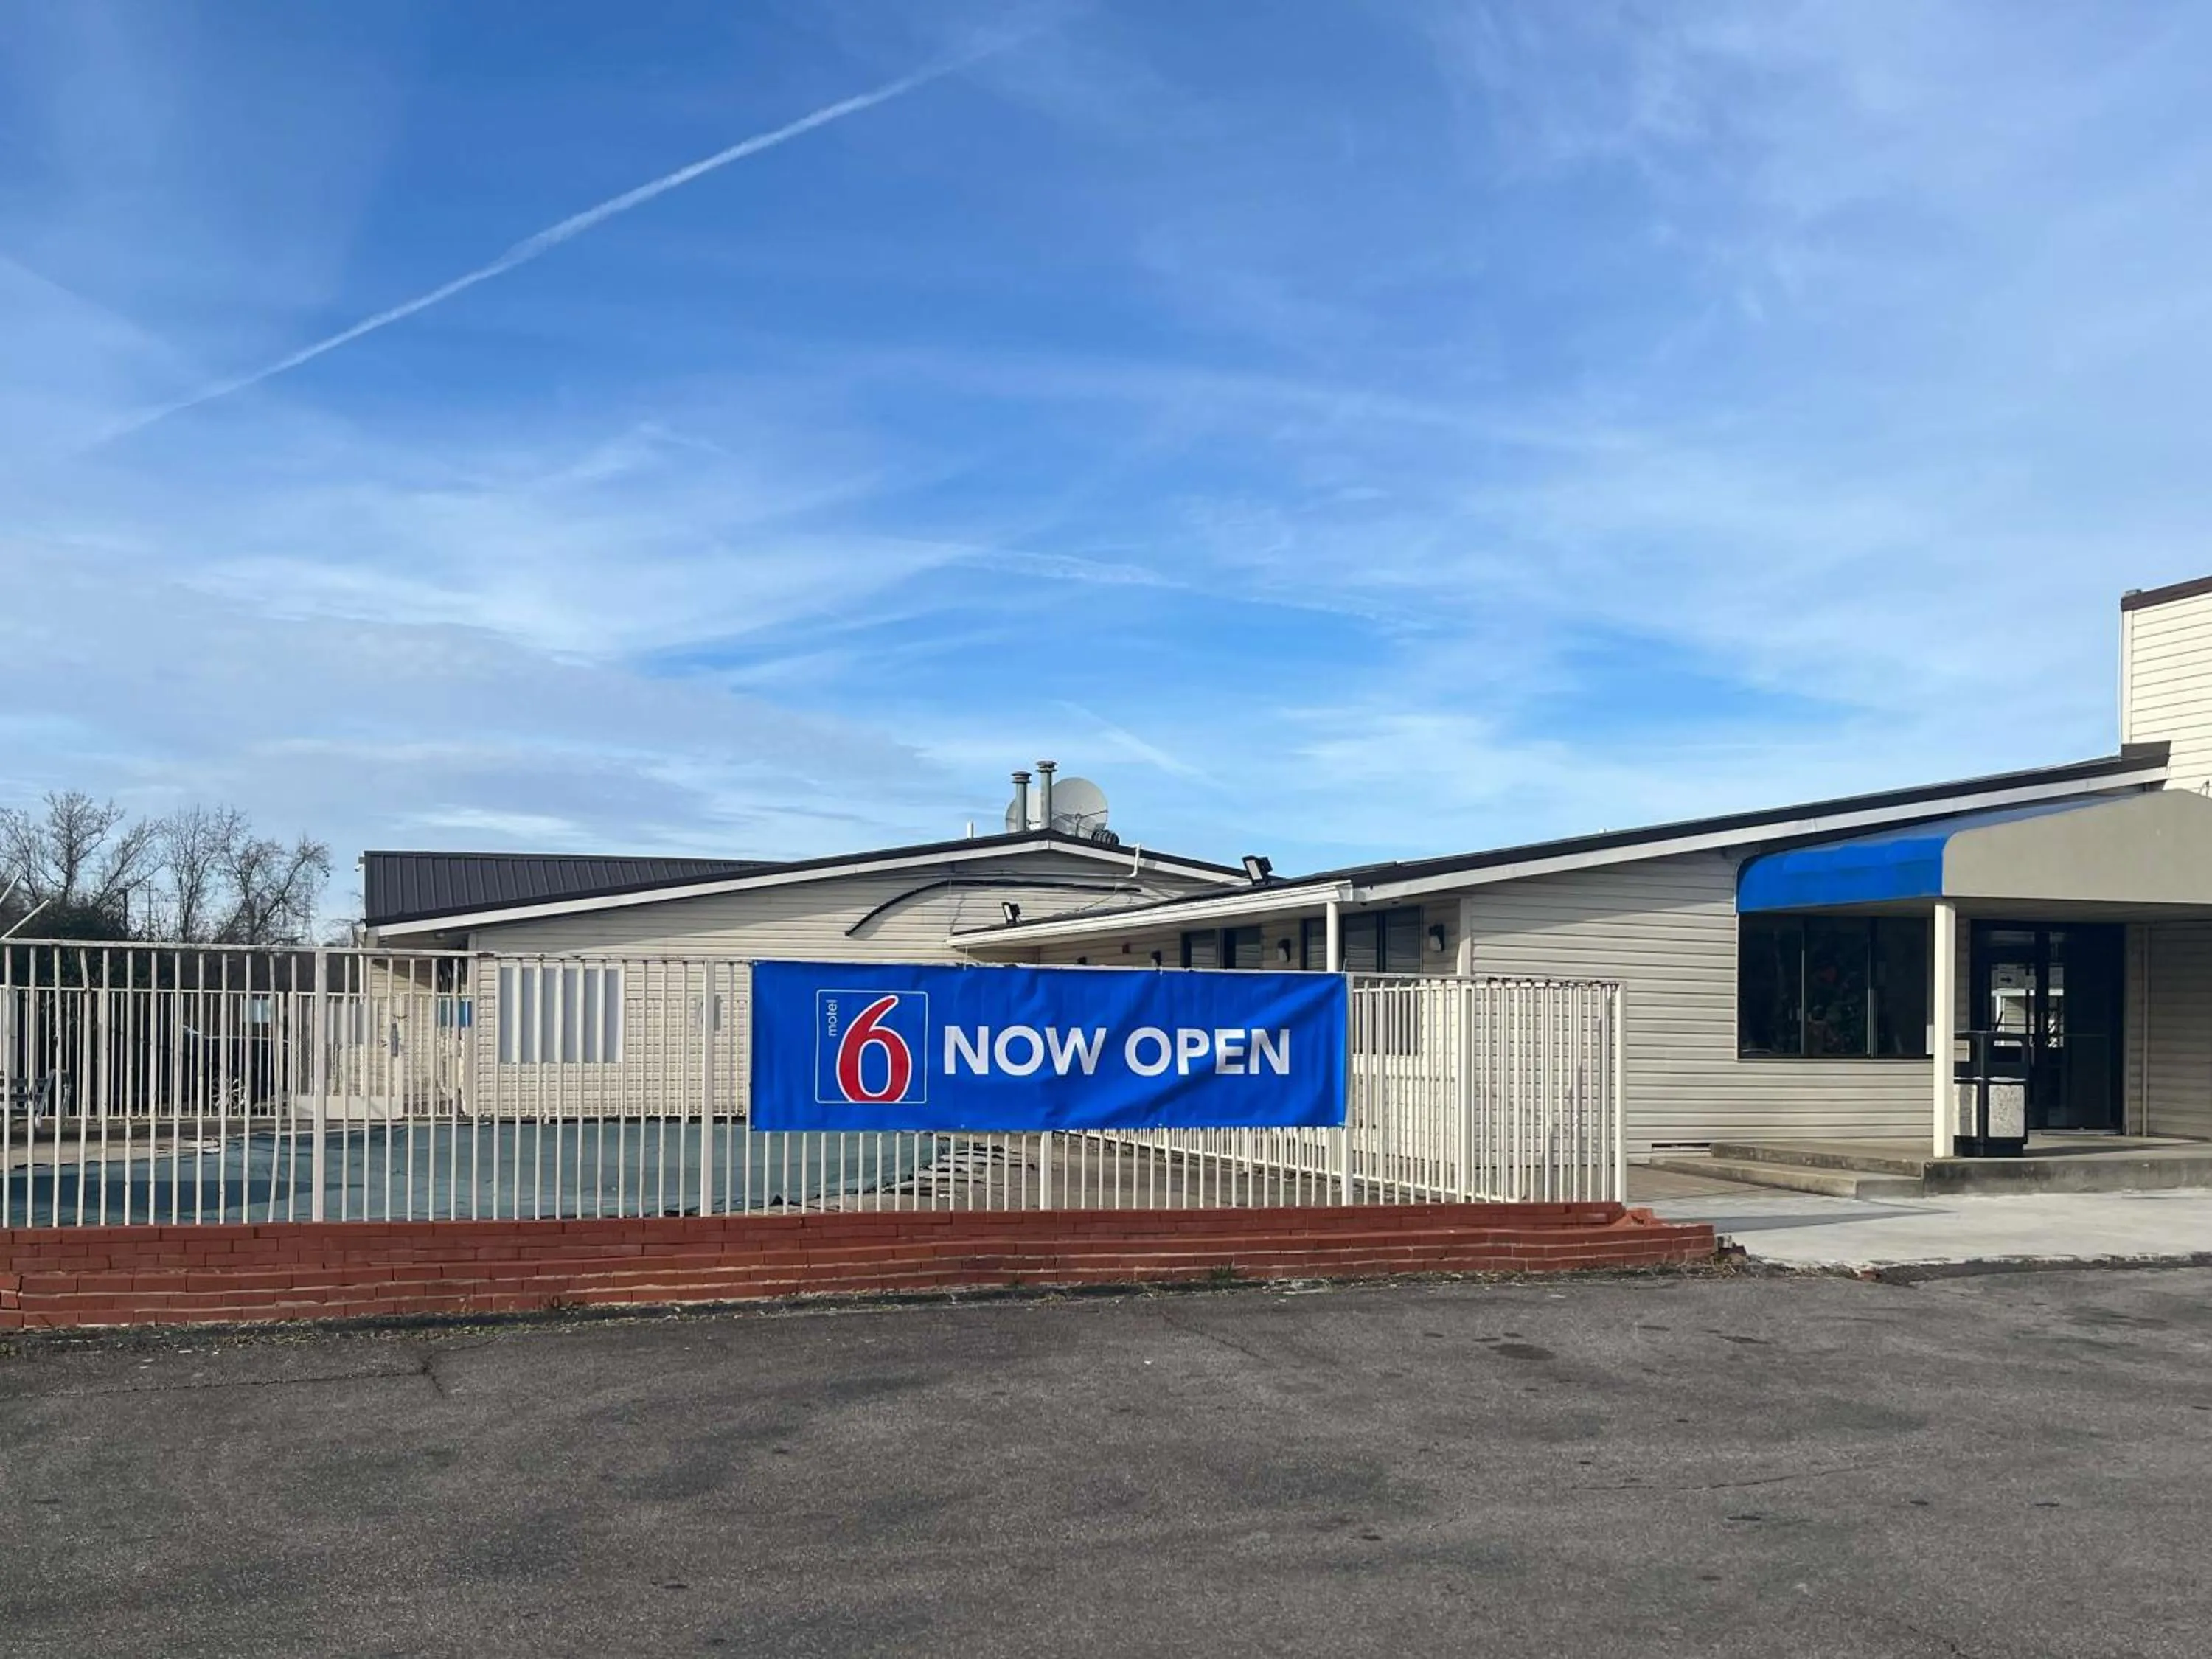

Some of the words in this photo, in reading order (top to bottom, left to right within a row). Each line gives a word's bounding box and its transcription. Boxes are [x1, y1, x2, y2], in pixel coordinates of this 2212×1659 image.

[826, 999, 838, 1037] motel
[836, 995, 912, 1103] 6
[944, 1025, 1107, 1076] NOW
[1124, 1026, 1290, 1077] OPEN
